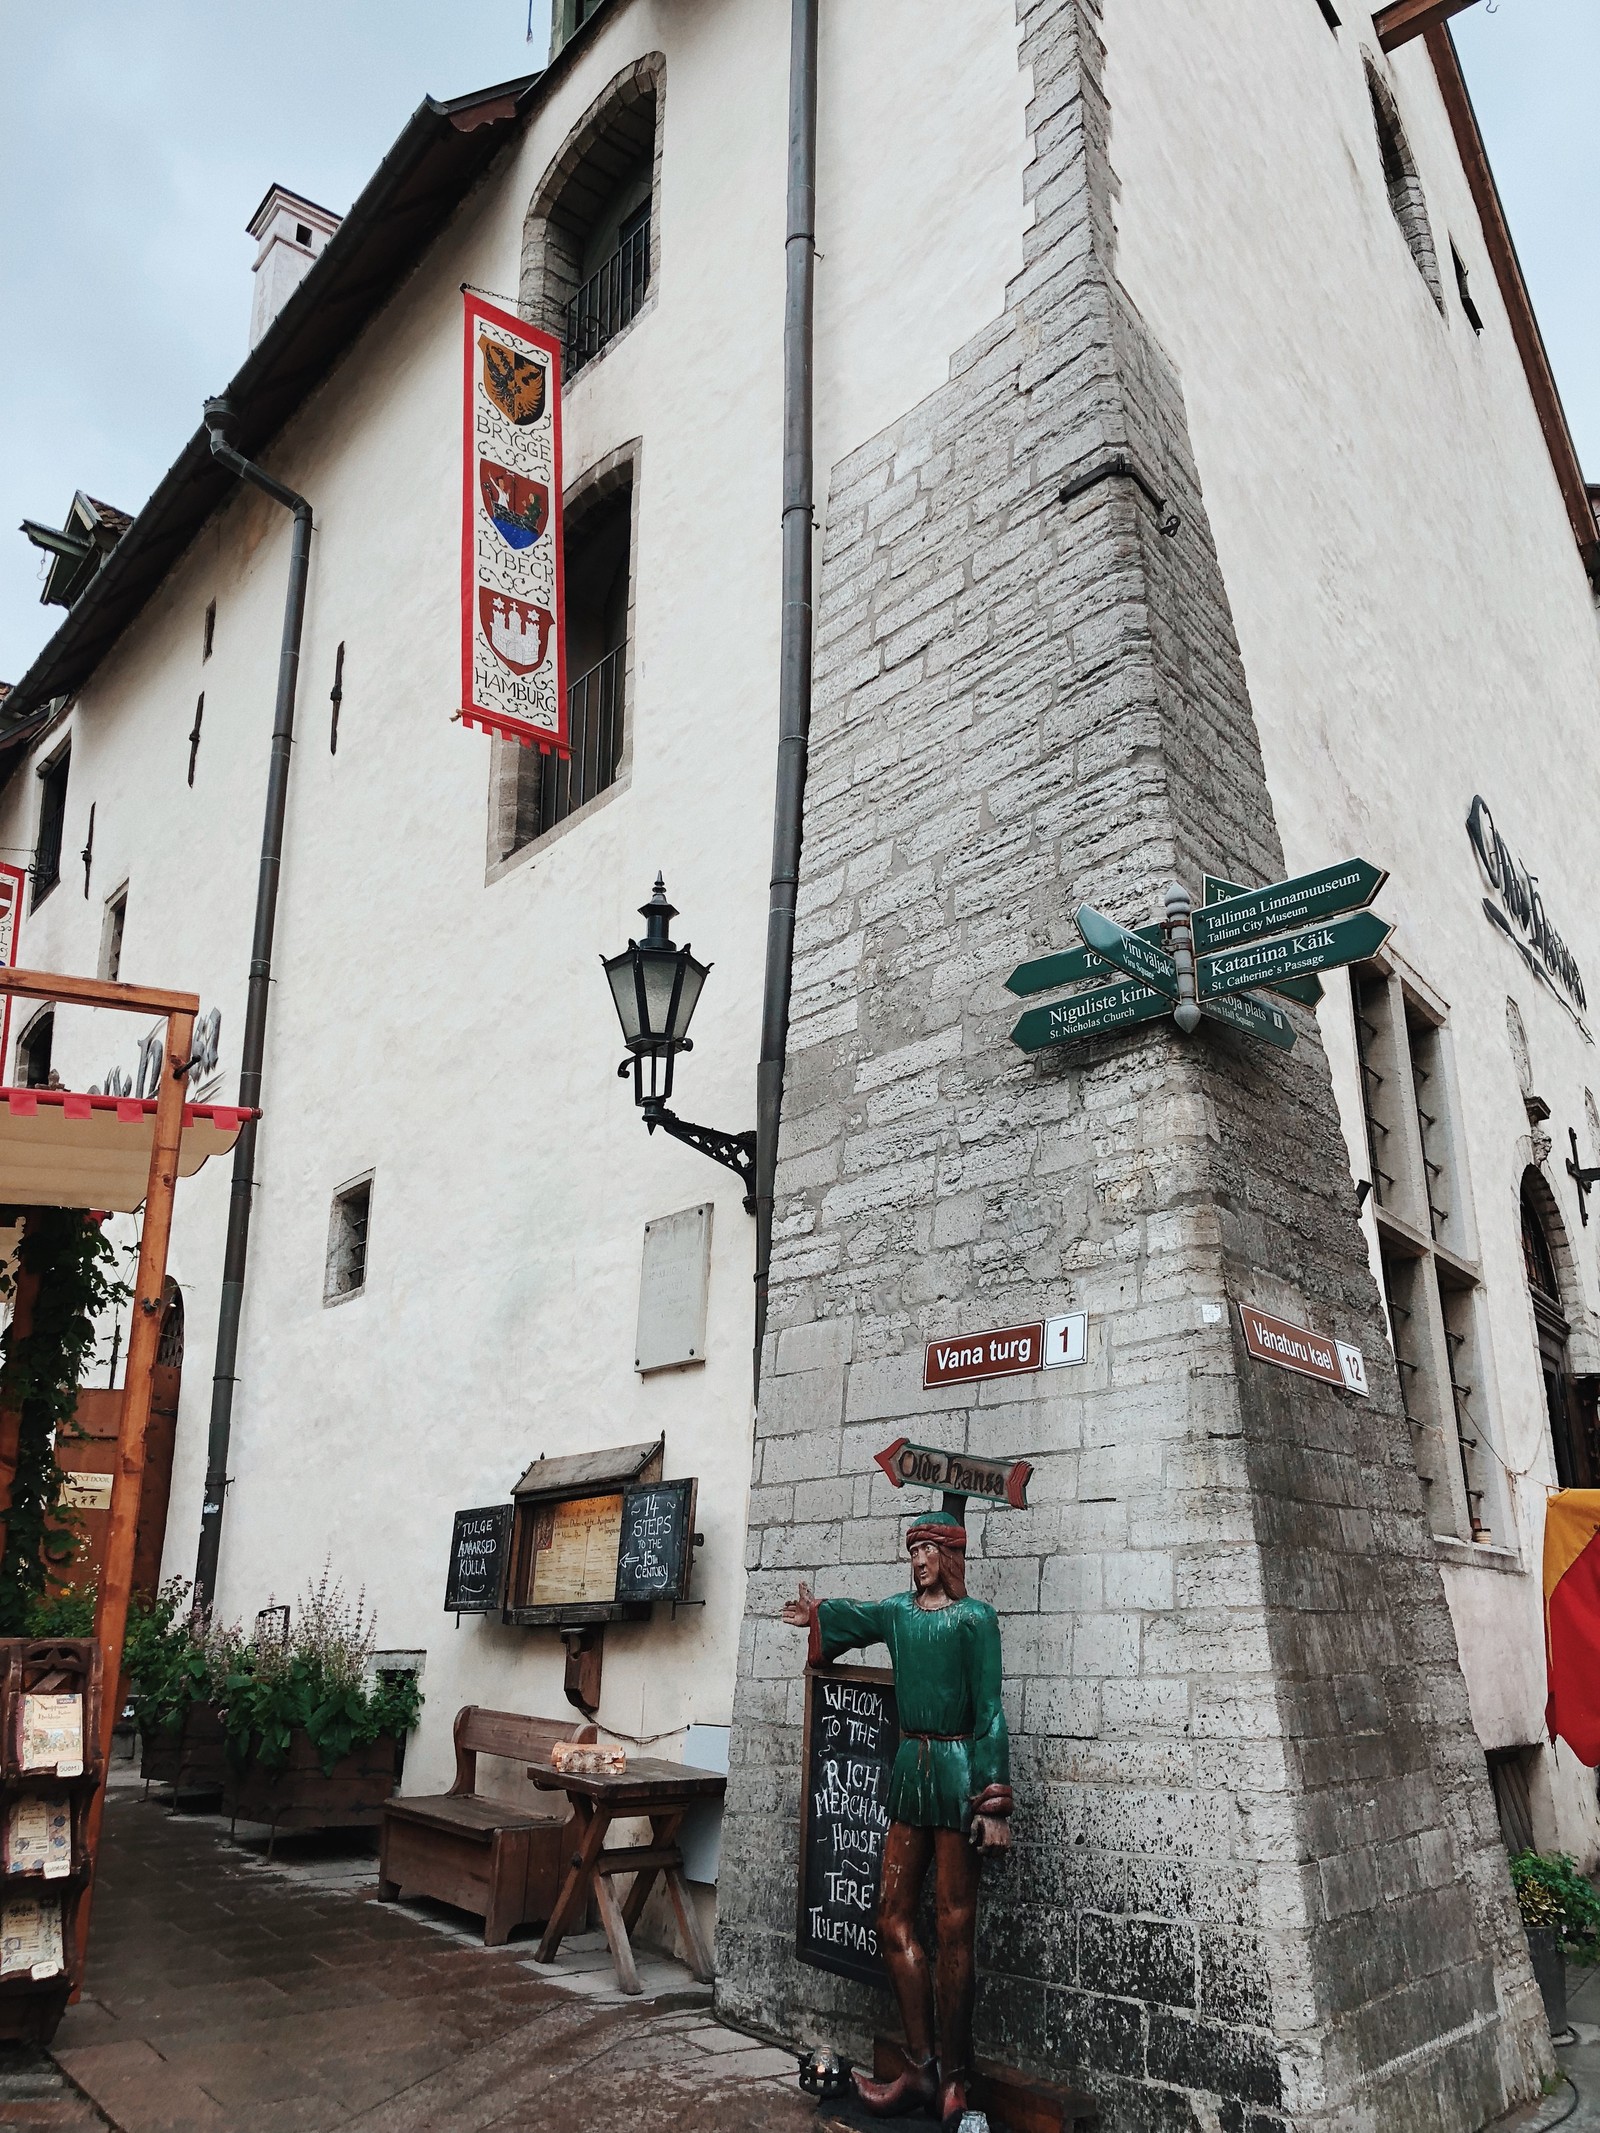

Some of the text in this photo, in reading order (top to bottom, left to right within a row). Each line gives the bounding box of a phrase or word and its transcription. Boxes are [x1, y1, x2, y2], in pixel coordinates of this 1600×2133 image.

[477, 415, 552, 463] BRYGGE
[478, 539, 554, 586] LYBECK
[475, 667, 557, 713] HAMBURG
[1206, 872, 1361, 930] Tallinna Linnamuuseum
[1207, 906, 1309, 944] Tallinn City Museum
[1120, 934, 1171, 978] Viru väljak
[1122, 954, 1155, 980] Viru Square
[1210, 929, 1335, 977] Katariina Käik
[1211, 981, 1225, 992] St.
[1284, 954, 1325, 972] Passage
[1049, 995, 1117, 1026] Niguliste
[1050, 1006, 1135, 1040] St. Nicholas Church
[1206, 1002, 1255, 1028] Town Hall Square
[1244, 1001, 1267, 1022] plats
[936, 1337, 1032, 1371] Vana turg
[1059, 1326, 1069, 1353] 1
[1252, 1319, 1335, 1372] Vanaturu kael
[1345, 1354, 1363, 1382] 12
[899, 1450, 942, 1484] Olde
[644, 1493, 659, 1518] 14
[462, 1519, 494, 1538] TULGE
[632, 1514, 672, 1538] STEPS
[637, 1537, 663, 1550] TO THE
[821, 1714, 880, 1751] TO THE
[826, 1759, 881, 1795] RICH
[814, 1789, 891, 1835] MERCHAN
[831, 1822, 881, 1857] HOUSE
[823, 1870, 875, 1912] TERE
[808, 1905, 883, 1958] TULEMAS
